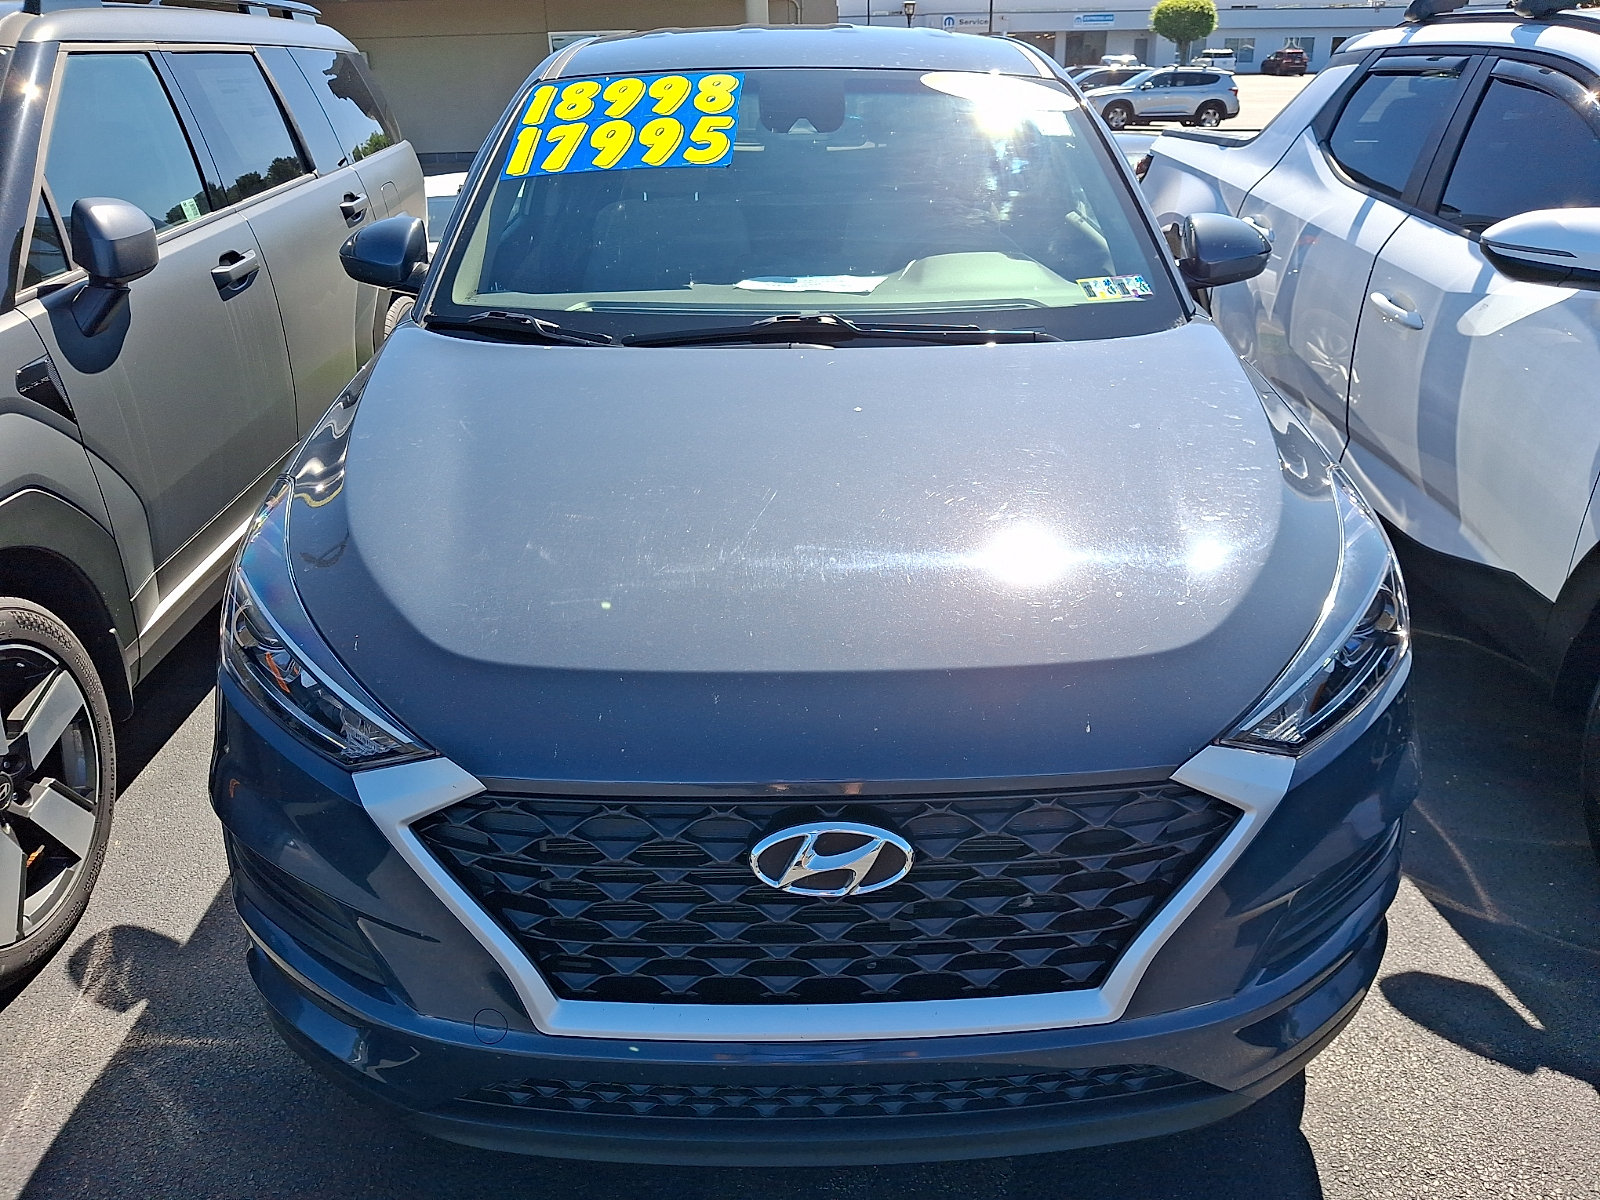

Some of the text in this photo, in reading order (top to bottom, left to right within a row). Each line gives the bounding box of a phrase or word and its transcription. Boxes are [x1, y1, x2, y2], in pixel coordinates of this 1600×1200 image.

[959, 18, 989, 26] Service
[522, 74, 739, 125] 18998
[505, 116, 736, 176] 17995
